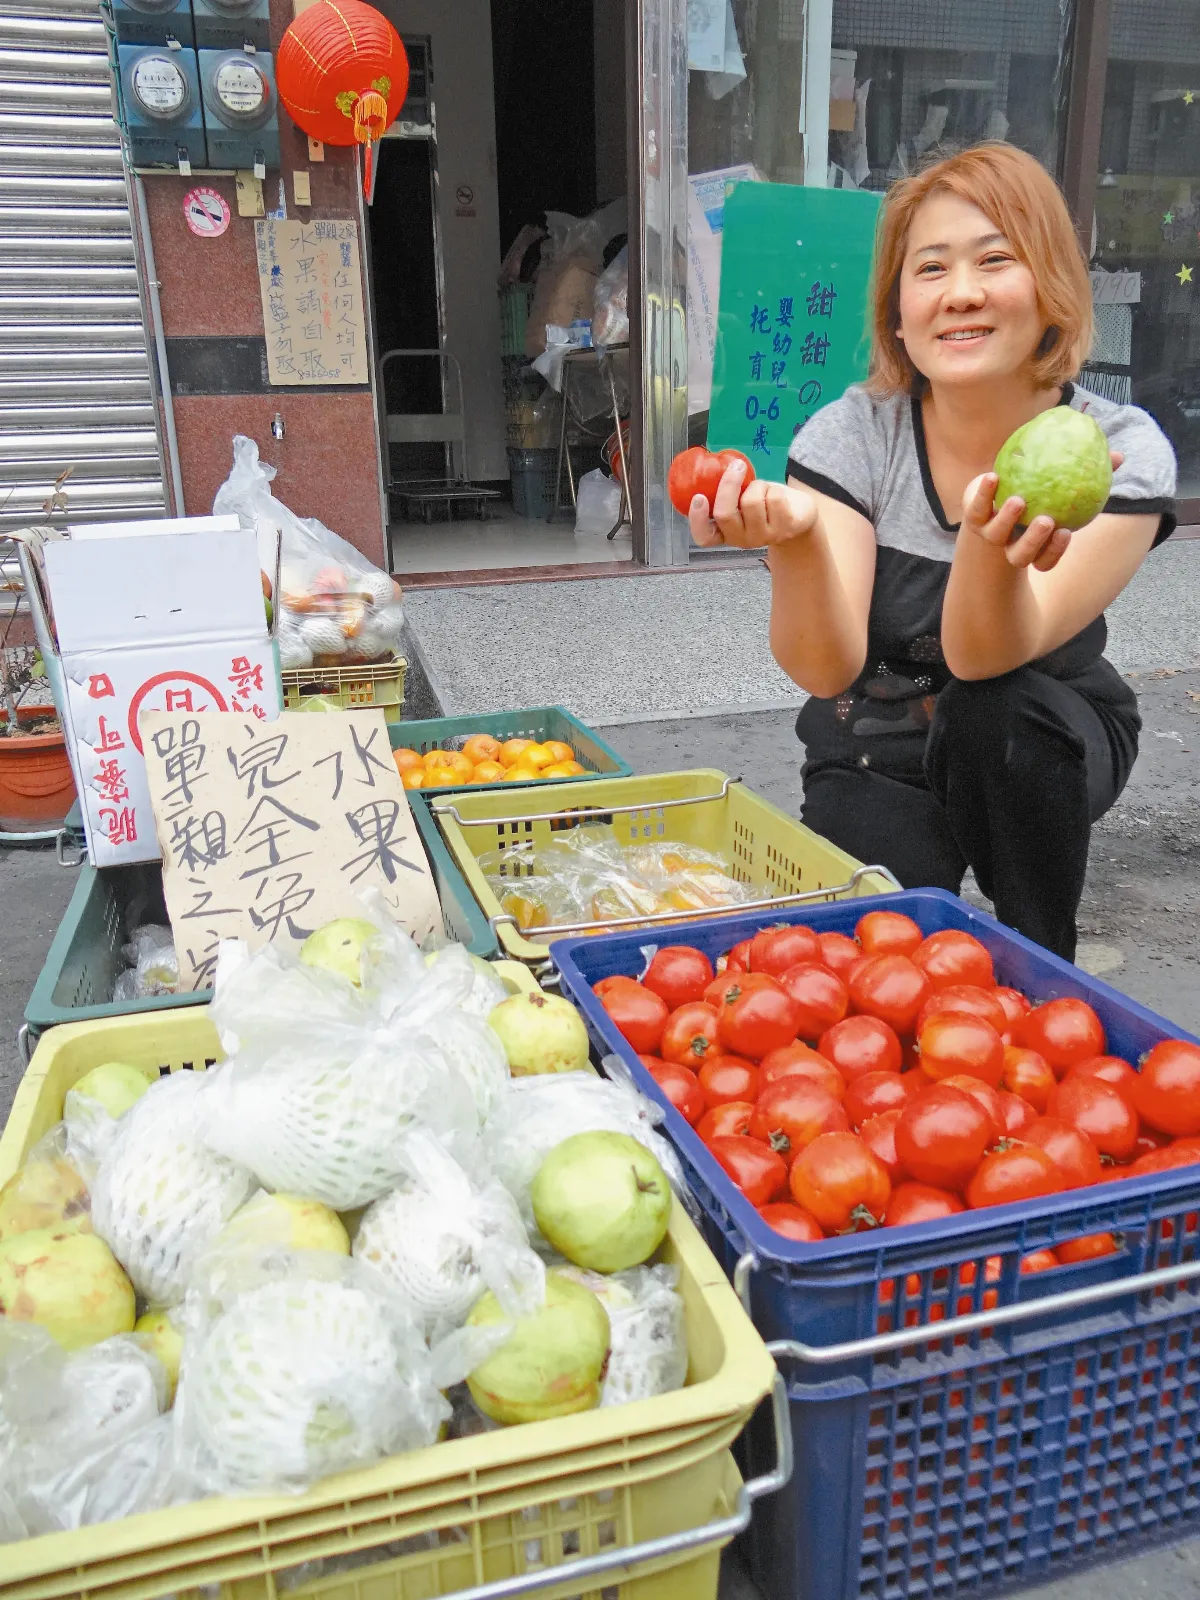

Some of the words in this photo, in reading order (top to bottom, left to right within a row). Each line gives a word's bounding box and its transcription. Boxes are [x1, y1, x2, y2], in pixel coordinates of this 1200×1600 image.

[290, 229, 326, 371] 水果請自取
[768, 297, 794, 388] 嬰幼兒
[793, 281, 837, 436] 甜甜の
[88, 673, 139, 846] 脆蜜可口
[227, 724, 321, 941] 完全免
[313, 724, 425, 884] 水果
